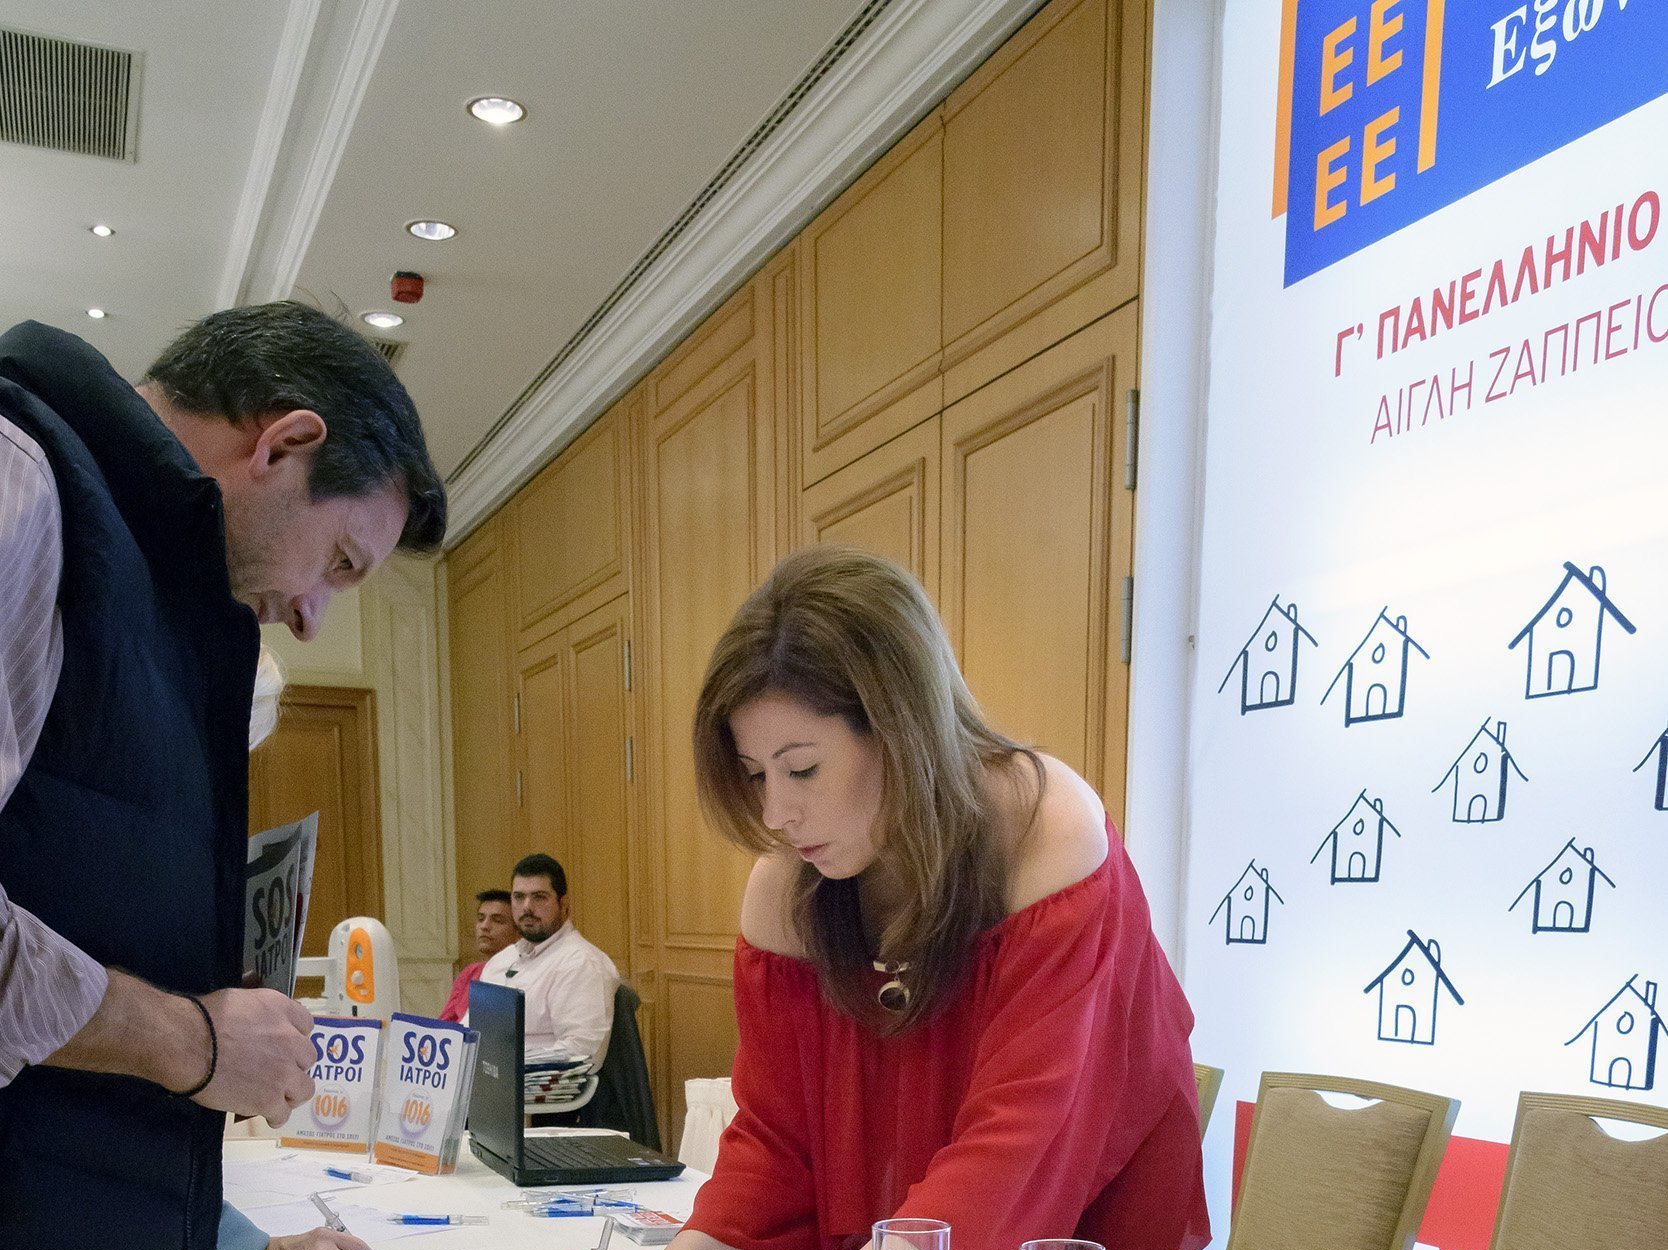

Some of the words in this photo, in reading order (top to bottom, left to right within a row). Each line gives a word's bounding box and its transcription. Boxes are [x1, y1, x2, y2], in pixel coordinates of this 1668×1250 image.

[1376, 190, 1661, 360] ΠΑΝΕΛΛΗΝΙΟ
[1370, 359, 1474, 445] ΑΙΓΛΗ
[252, 862, 294, 950] SOS
[309, 1031, 366, 1066] SOS
[401, 1030, 452, 1071] SOS
[400, 1065, 447, 1090] ΙΑΤΡΟΙ
[314, 1094, 348, 1118] 1016
[403, 1098, 431, 1126] 1016
